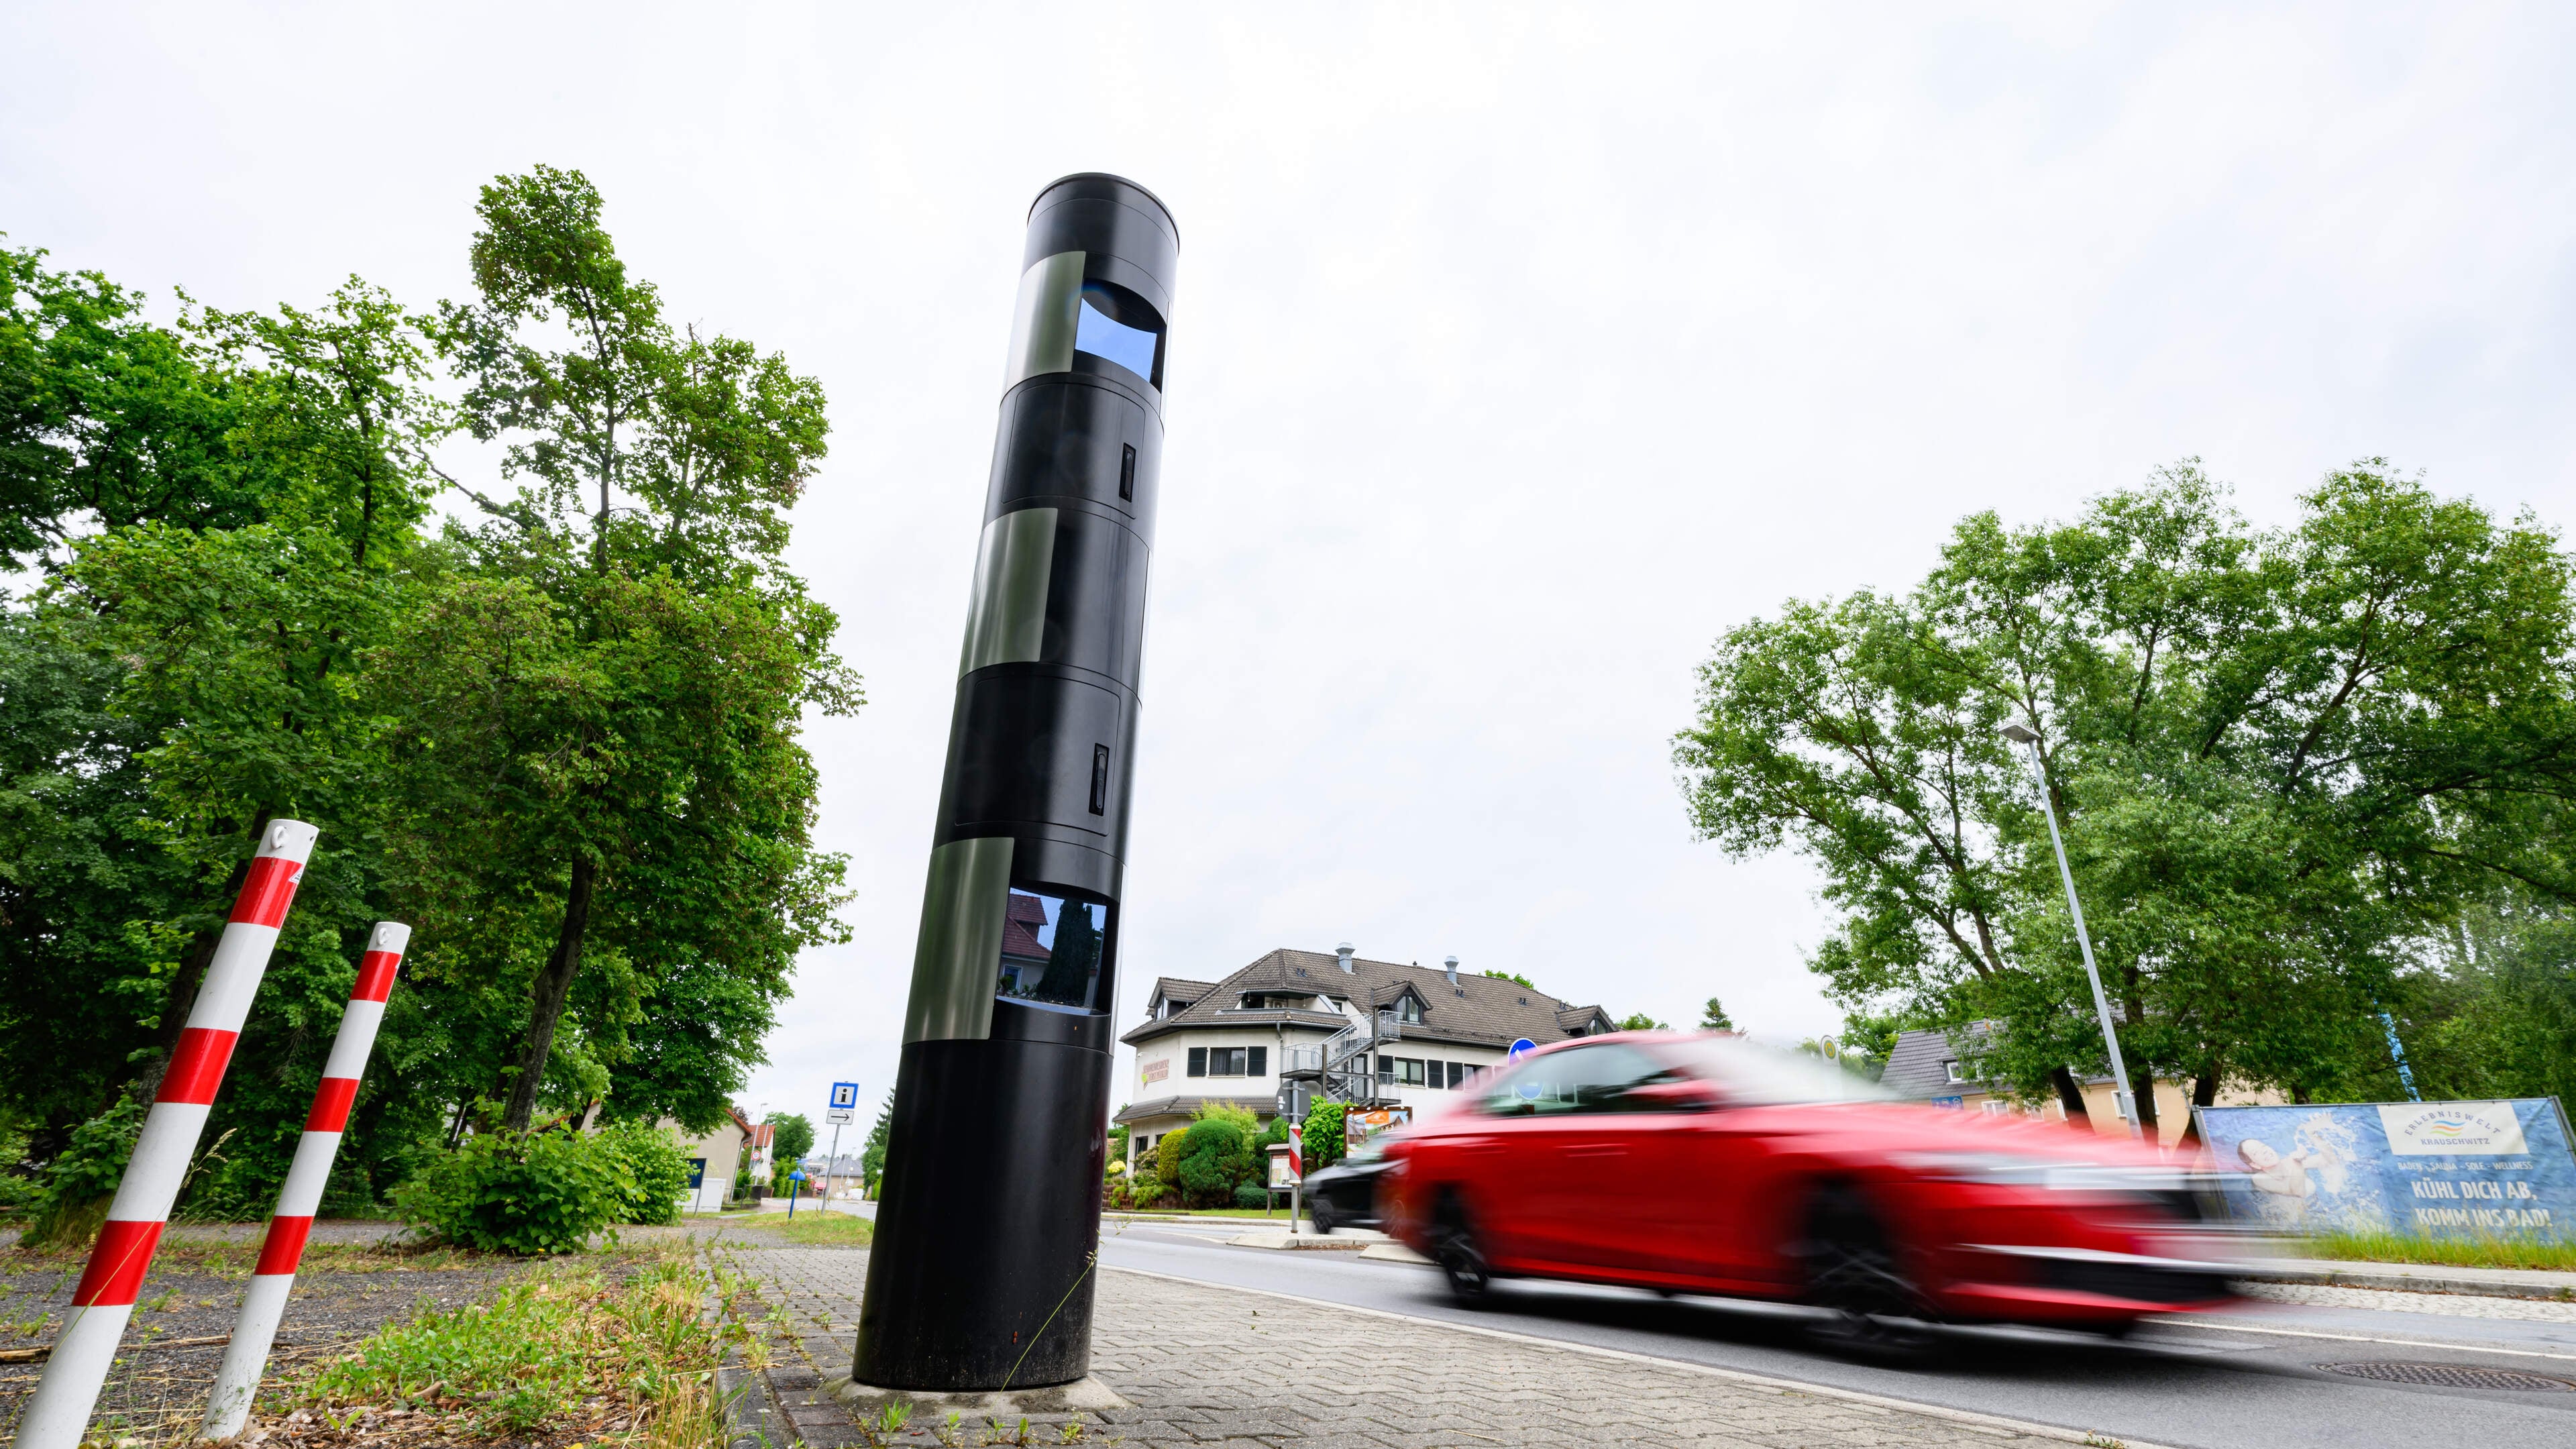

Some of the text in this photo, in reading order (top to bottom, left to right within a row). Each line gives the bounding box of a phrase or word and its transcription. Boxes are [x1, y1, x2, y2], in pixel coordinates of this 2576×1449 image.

[2404, 1111, 2501, 1136] ERLEBNISWELT
[2398, 1162, 2422, 1171] BADEN
[2431, 1162, 2458, 1171] SAUNA
[2466, 1162, 2484, 1170] SOLE
[2493, 1161, 2533, 1170] WELLNESS
[2410, 1177, 2537, 1200] KÜHL DICH AB,
[2416, 1208, 2553, 1227] KOMM INS BAD!
